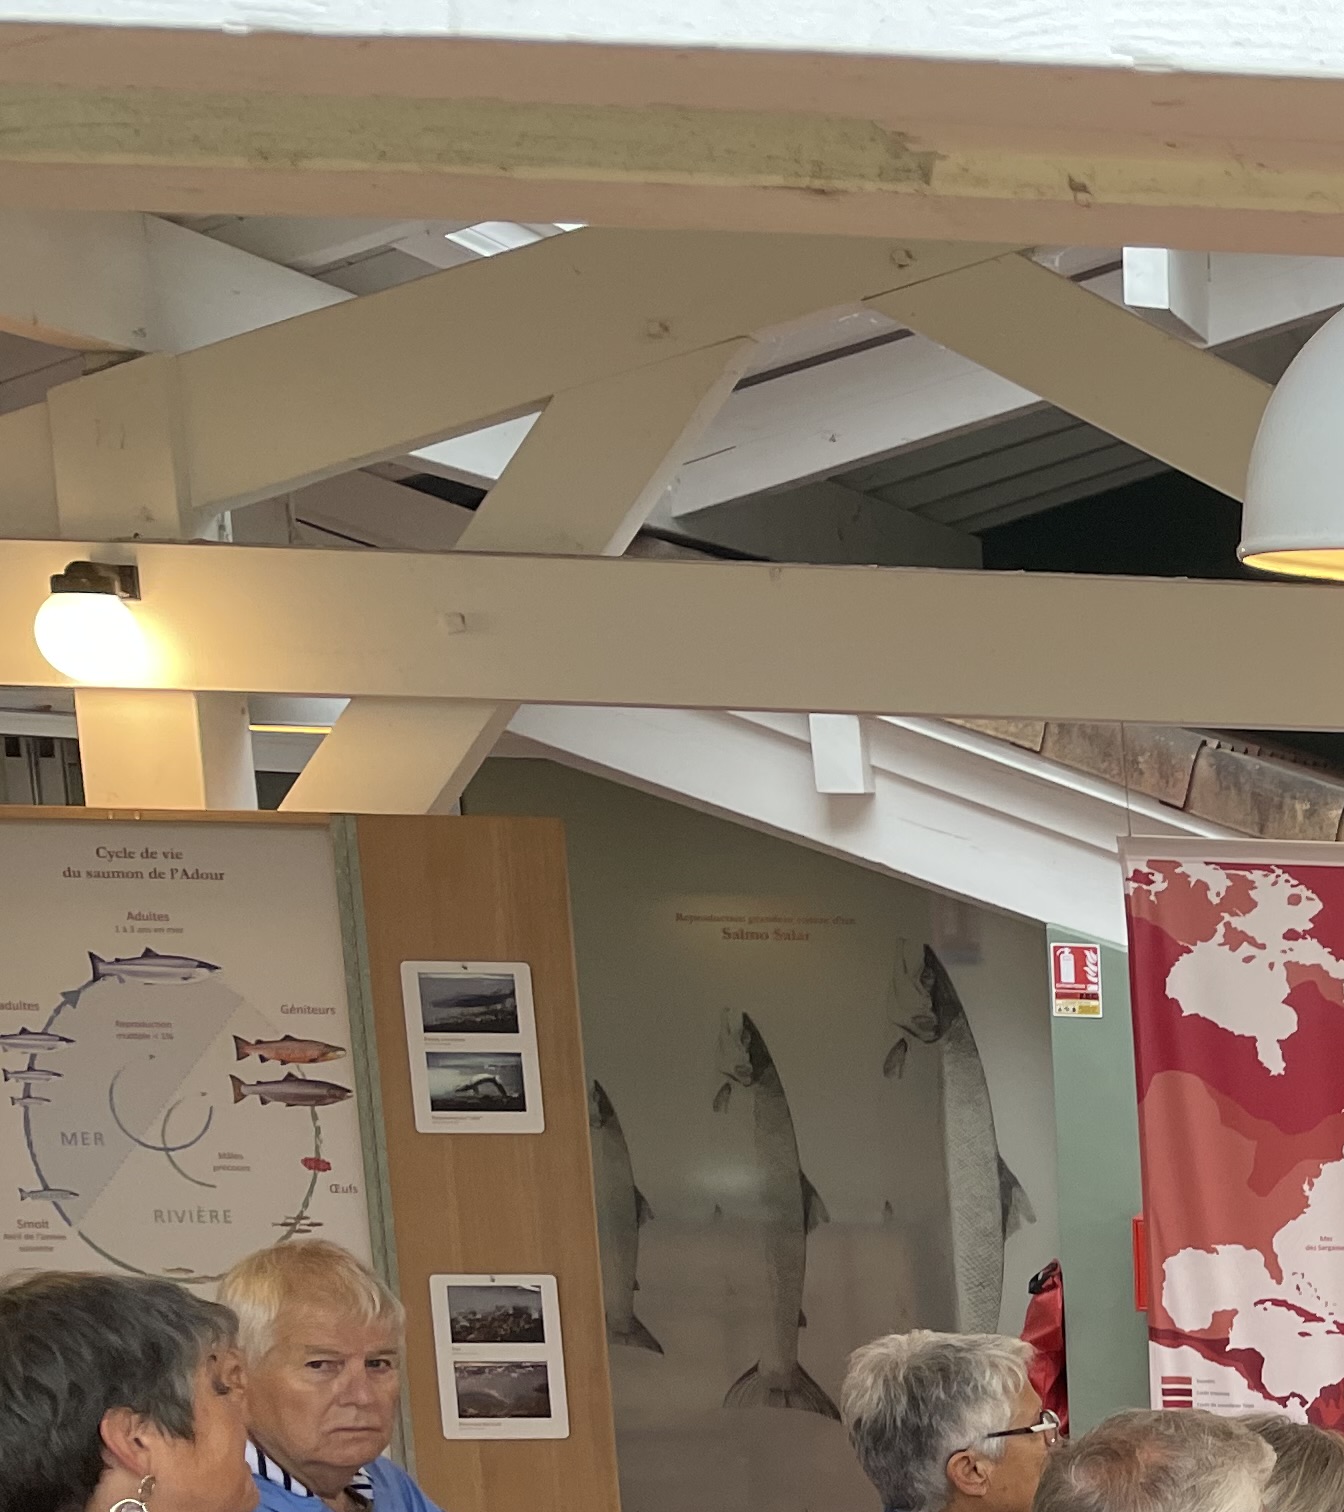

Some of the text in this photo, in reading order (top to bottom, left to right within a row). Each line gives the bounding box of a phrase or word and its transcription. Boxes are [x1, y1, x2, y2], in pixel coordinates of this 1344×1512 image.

[96, 846, 184, 862] Cycle de vie
[62, 866, 224, 880] du saumon de l'Adour
[126, 912, 170, 922] Adultes
[280, 1004, 336, 1016] Géniteurs
[60, 1132, 105, 1146] MER
[329, 1184, 358, 1195] Œufs
[154, 1207, 232, 1224] RIVIÈRE
